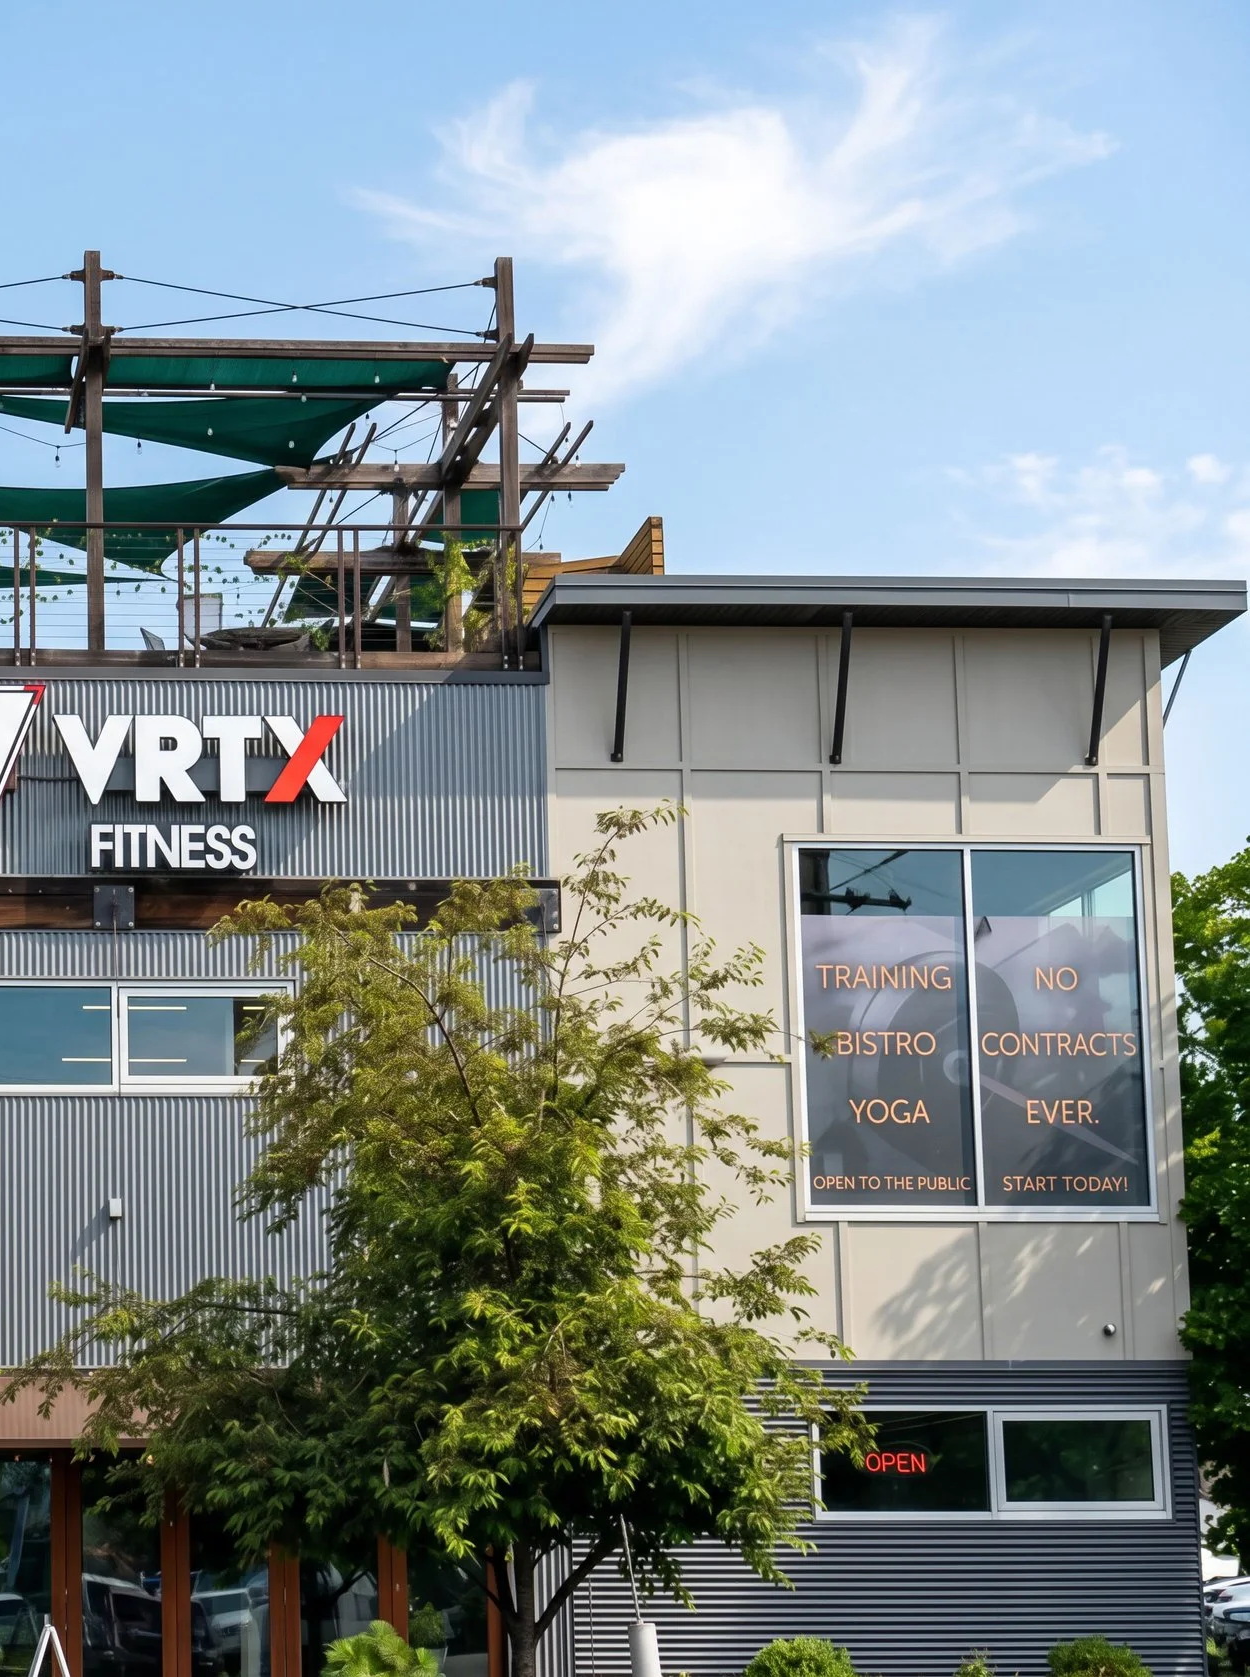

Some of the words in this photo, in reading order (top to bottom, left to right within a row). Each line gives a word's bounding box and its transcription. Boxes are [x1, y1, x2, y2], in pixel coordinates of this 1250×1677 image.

[53, 714, 348, 804] VRTX
[91, 824, 257, 870] FITNESS
[815, 965, 952, 989] TRAINING
[1035, 966, 1078, 991] NO
[837, 1031, 936, 1056] BISTRO
[981, 1032, 1137, 1056] CONTRACTS
[849, 1099, 931, 1124] YOGA
[1026, 1100, 1099, 1124] EVER.
[813, 1175, 855, 1190] OPEN
[859, 1176, 881, 1190] TO
[884, 1176, 914, 1190] THE
[918, 1177, 971, 1191] PUBLIC
[1003, 1176, 1058, 1191] START
[1061, 1176, 1128, 1191] TODAY!
[866, 1453, 926, 1473] OPEN
